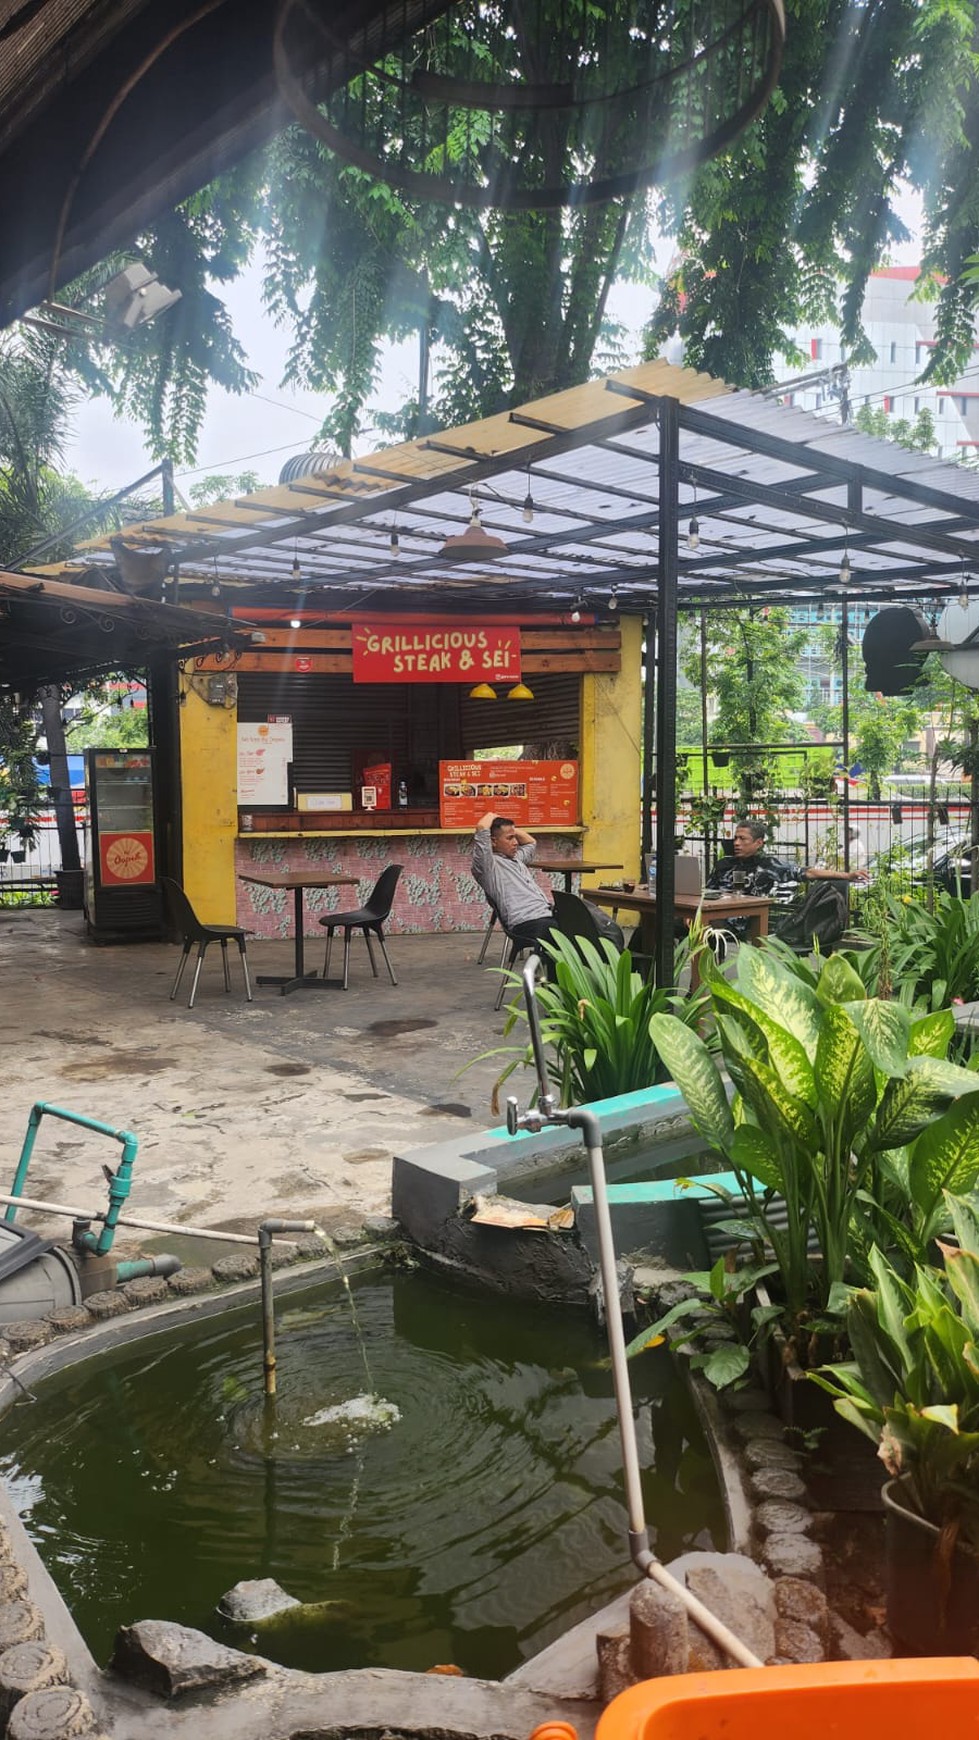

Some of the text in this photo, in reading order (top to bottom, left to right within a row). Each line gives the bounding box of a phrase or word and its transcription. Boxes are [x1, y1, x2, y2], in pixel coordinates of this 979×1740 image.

[367, 631, 488, 655] GRILLICIOUS
[393, 649, 509, 672] STEAK & SEI
